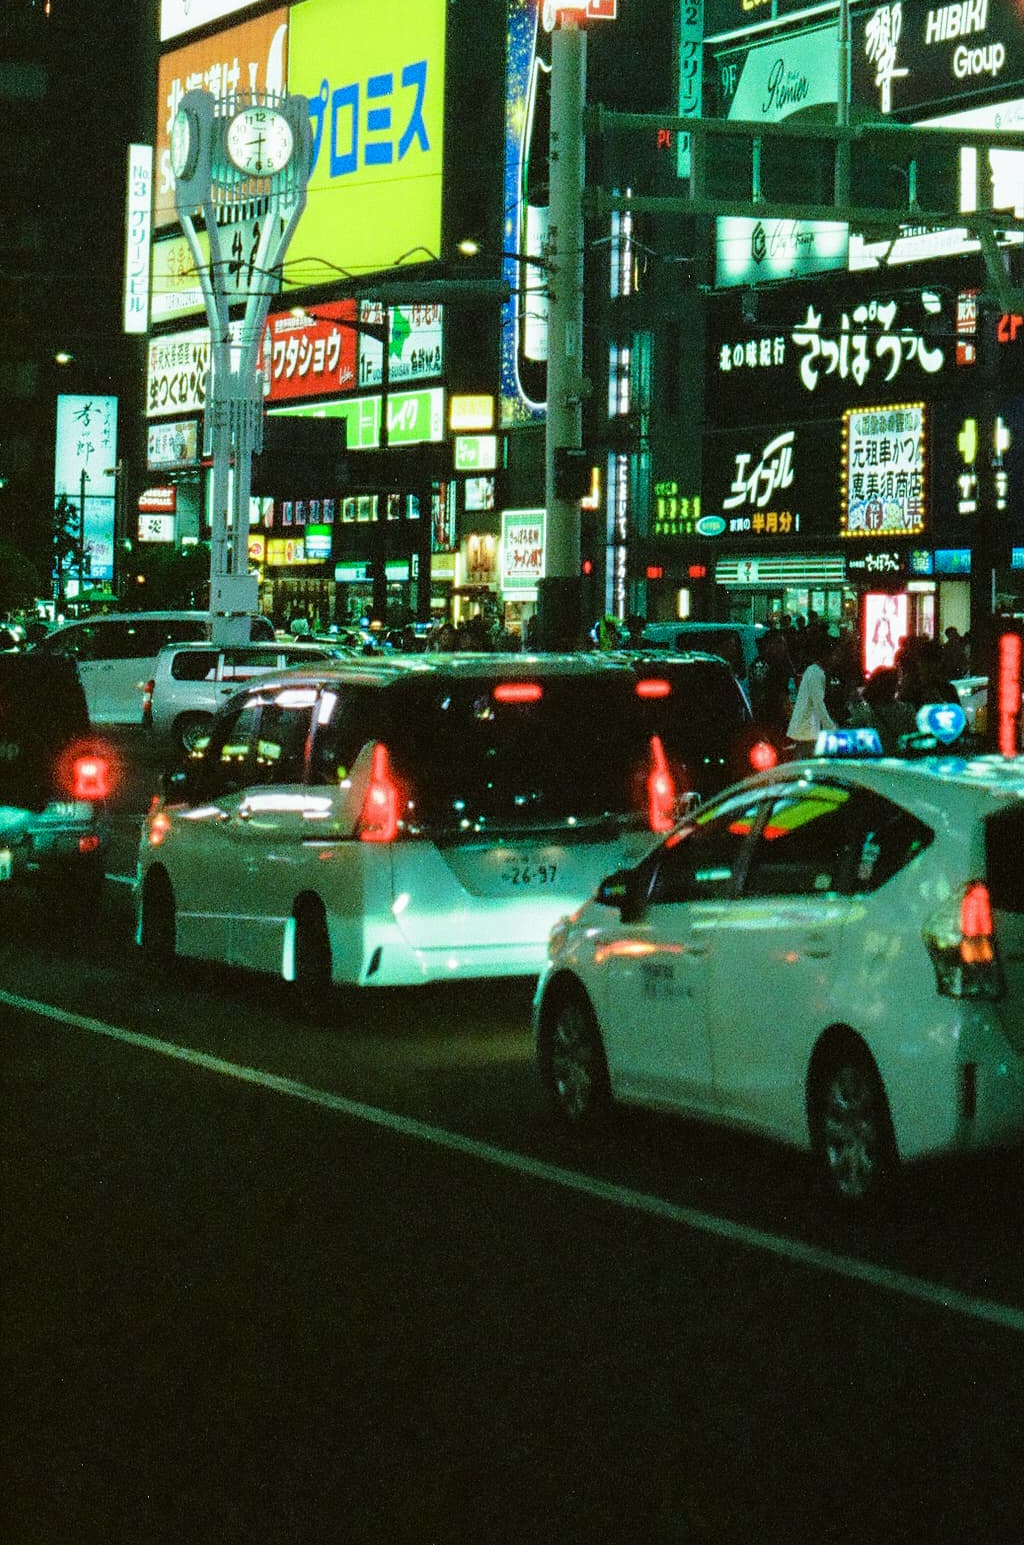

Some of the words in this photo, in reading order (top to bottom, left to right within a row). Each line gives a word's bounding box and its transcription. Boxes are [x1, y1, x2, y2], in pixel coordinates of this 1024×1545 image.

[953, 43, 1005, 78] Group
[307, 60, 430, 184] プロミス
[273, 328, 341, 379] ワタショウ
[720, 336, 785, 371] 北の味紀行
[723, 431, 796, 509] エイブル
